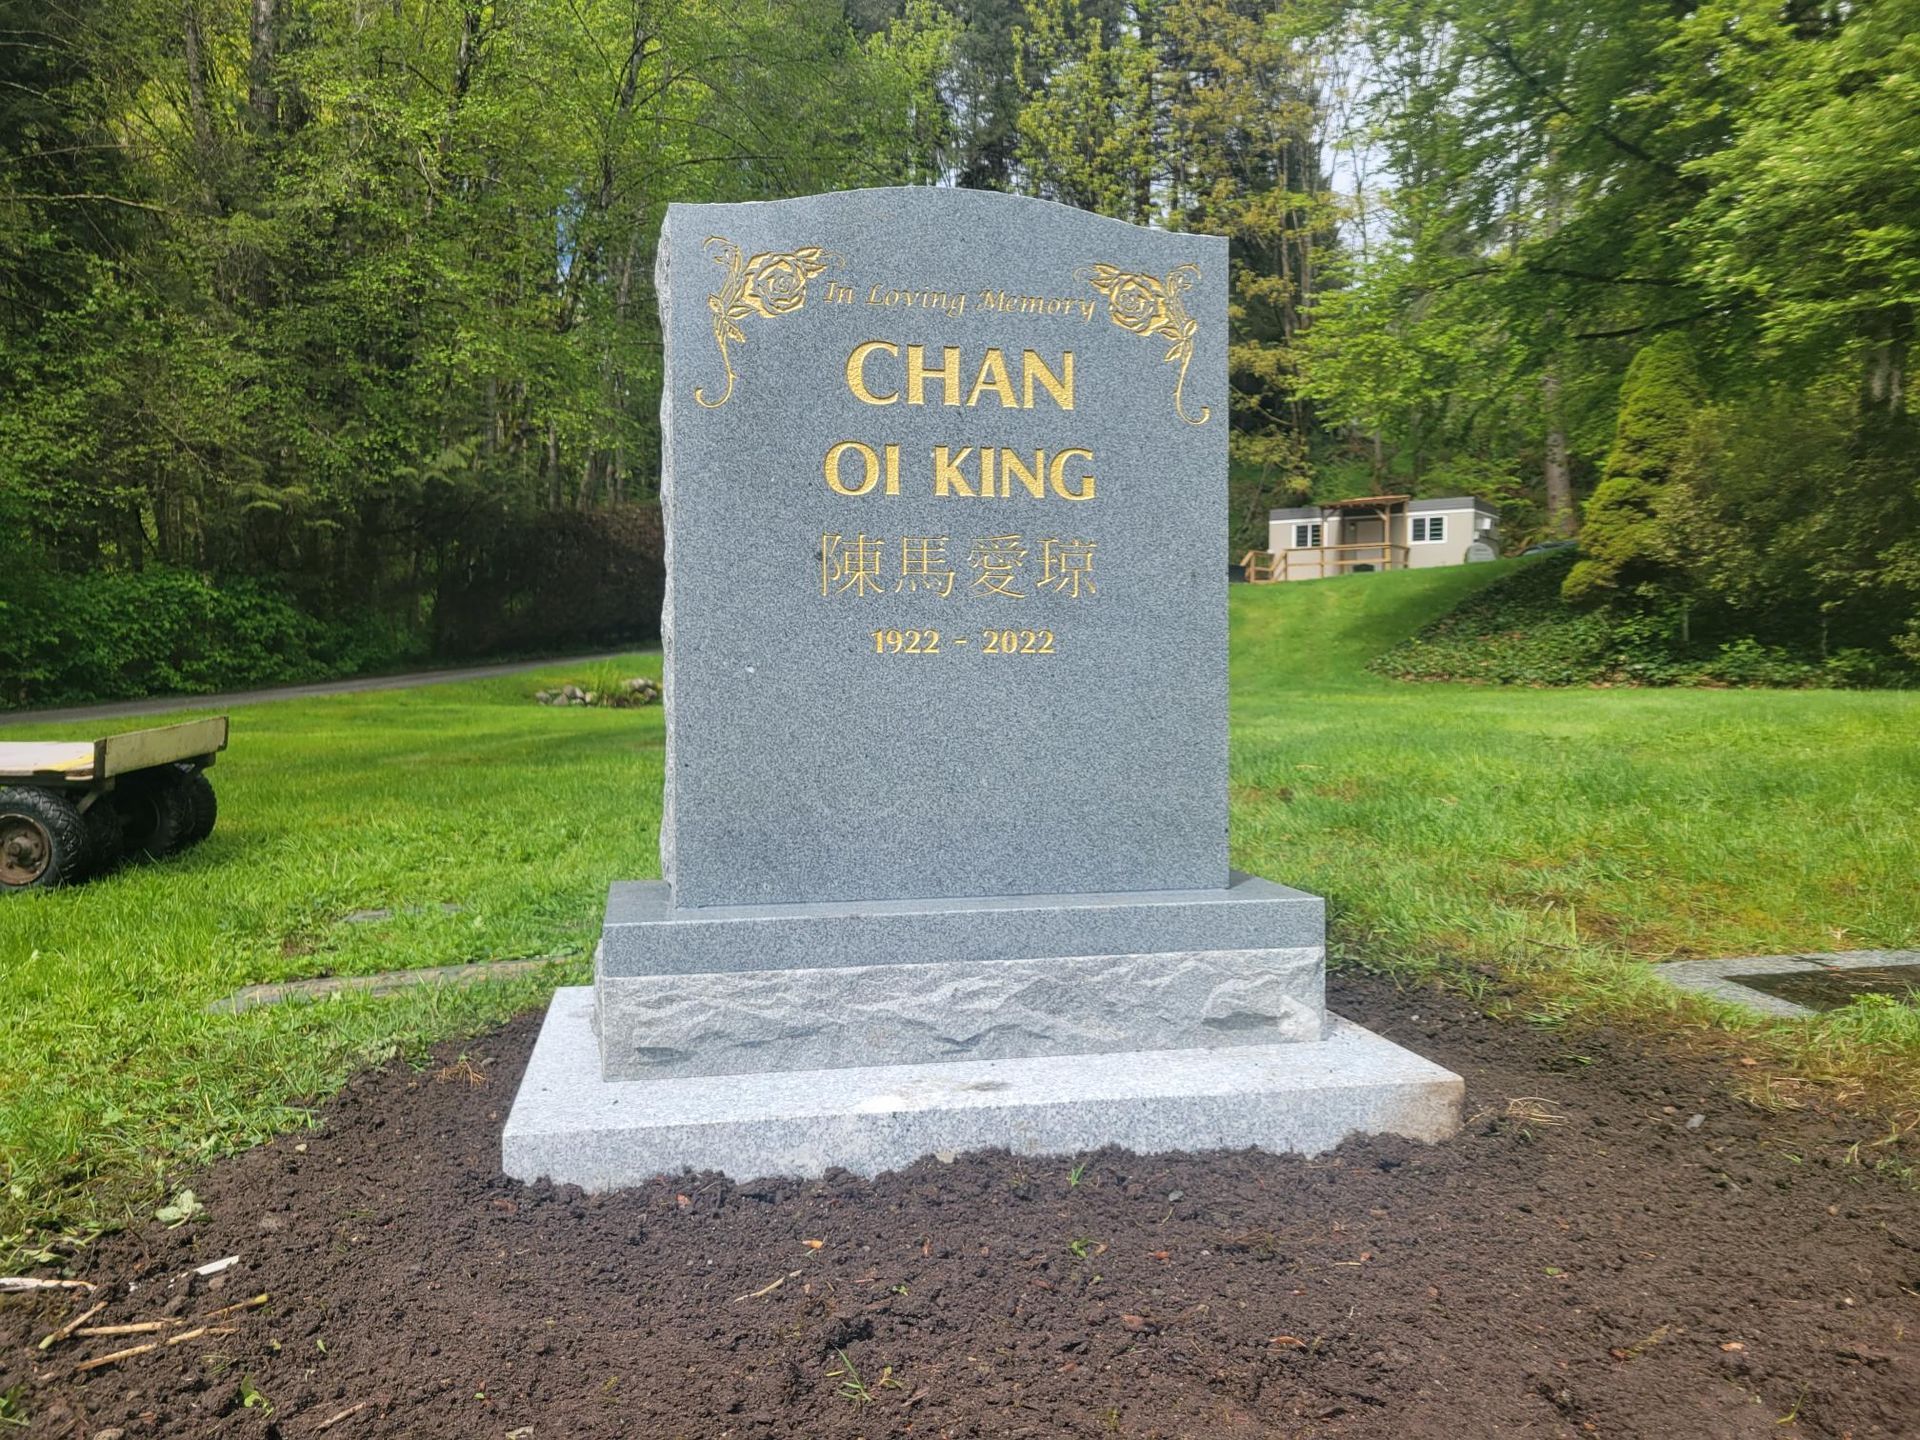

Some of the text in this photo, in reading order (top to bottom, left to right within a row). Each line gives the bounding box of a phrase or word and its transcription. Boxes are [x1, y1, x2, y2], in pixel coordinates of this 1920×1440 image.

[823, 280, 1096, 323] In Loving Memory
[846, 340, 1075, 411] CHAN
[824, 440, 1095, 500] OI KING
[820, 532, 1098, 598] 陳馬愛琼
[870, 629, 940, 653] 1922
[982, 629, 1055, 654] 2022
